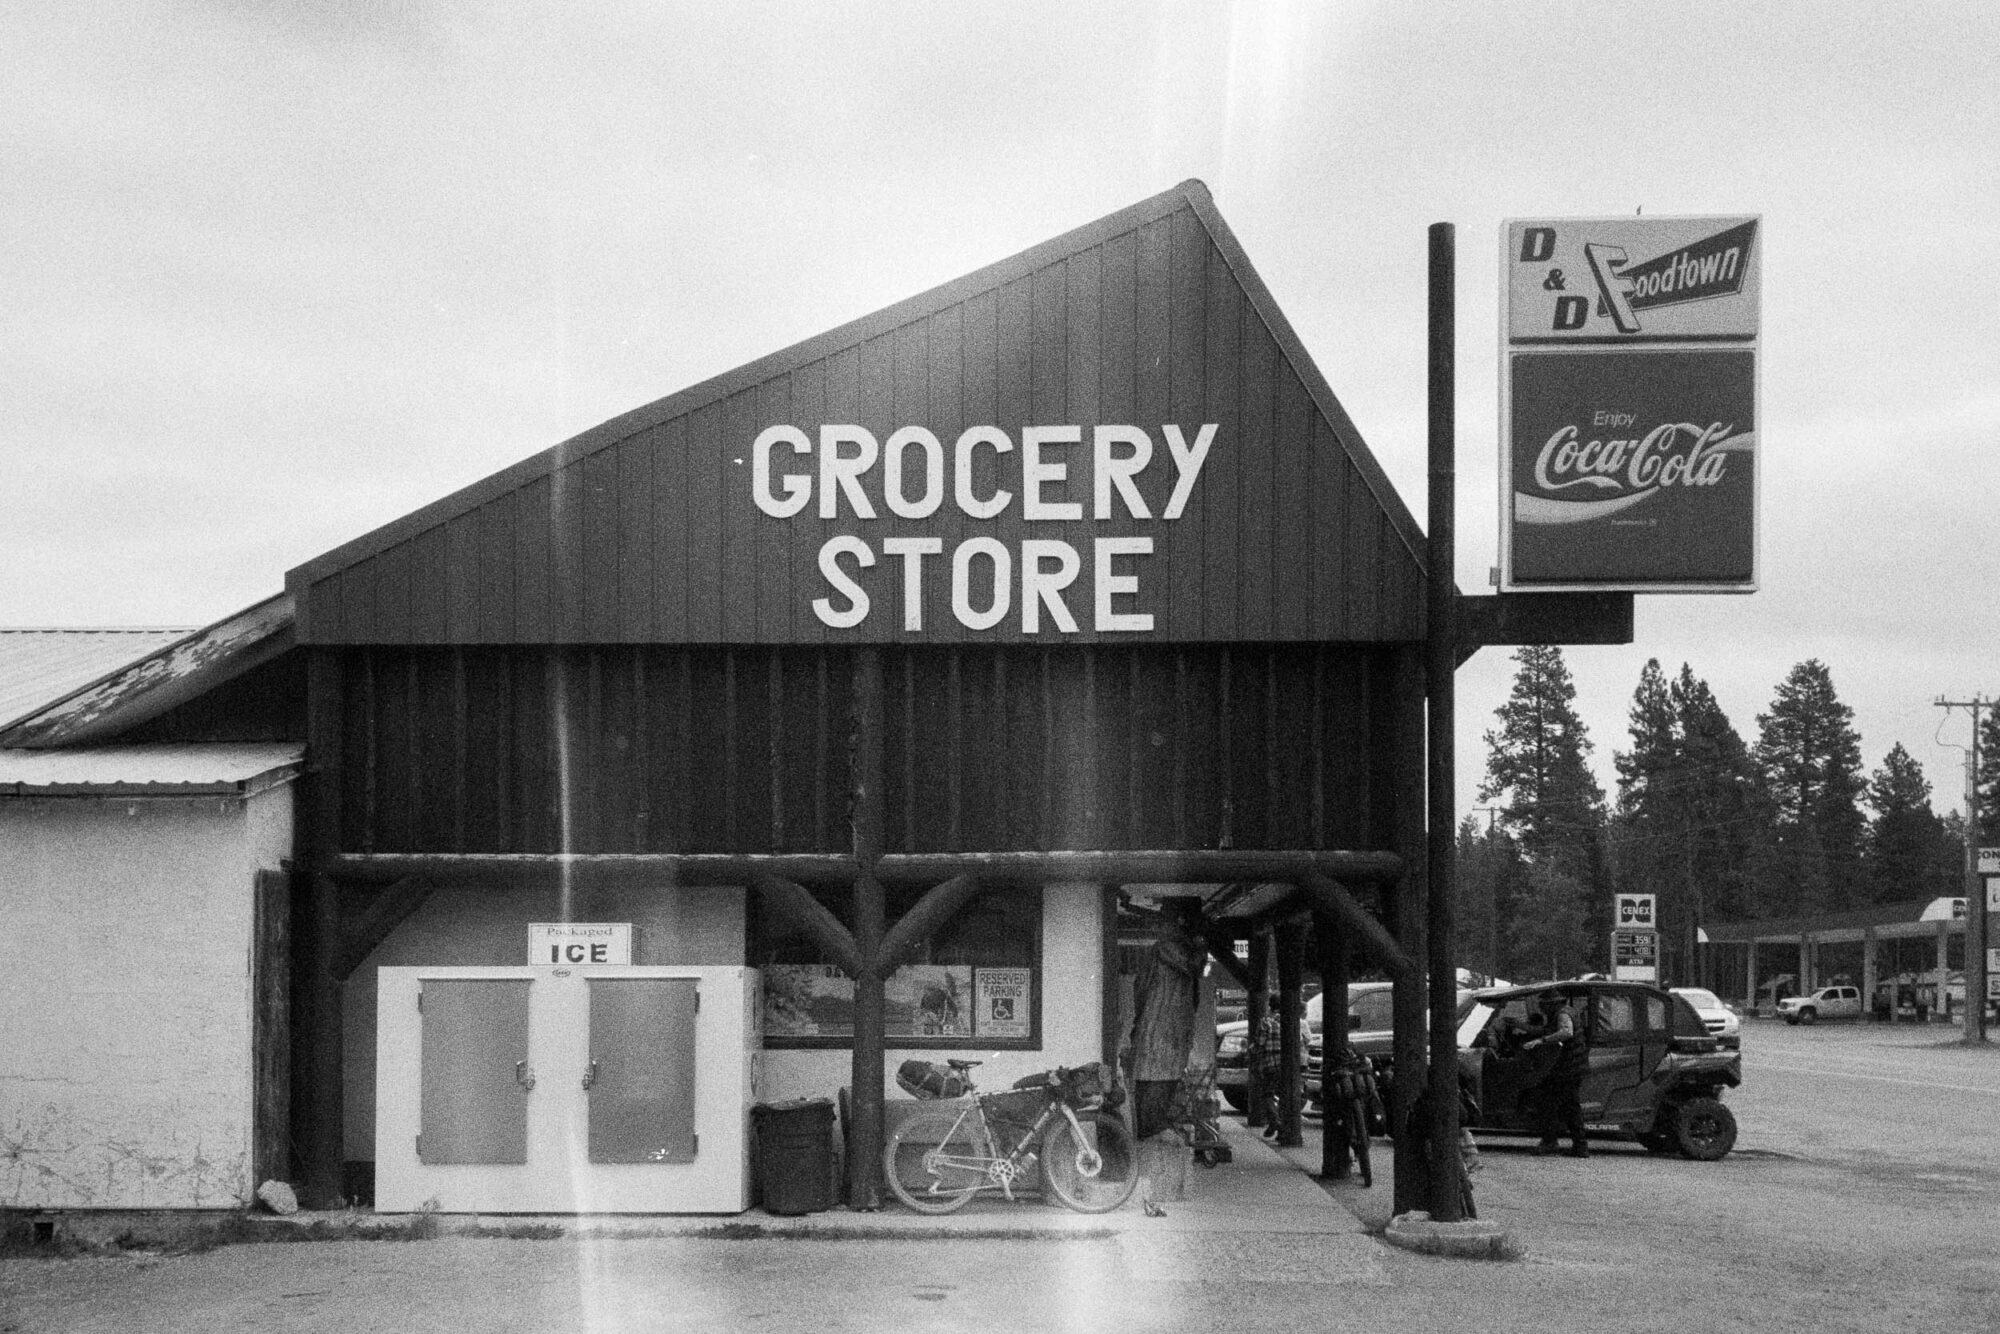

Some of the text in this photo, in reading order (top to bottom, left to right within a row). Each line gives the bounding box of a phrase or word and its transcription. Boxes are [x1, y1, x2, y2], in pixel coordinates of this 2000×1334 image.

[1520, 227, 1557, 262] D
[1542, 268, 1566, 291] &
[1584, 243, 1740, 333] Foodtown
[1552, 296, 1589, 330] D
[1593, 411, 1637, 428] Enjoy
[1535, 422, 1733, 490] Coca-Cola
[752, 424, 1219, 520] GROCERY
[812, 535, 1154, 633] STORE
[1622, 906, 1650, 915] CENEX
[547, 927, 612, 937] Packaged
[551, 944, 608, 963] ICE
[980, 973, 1025, 984] RESERVED
[984, 986, 1022, 997] PARKING
